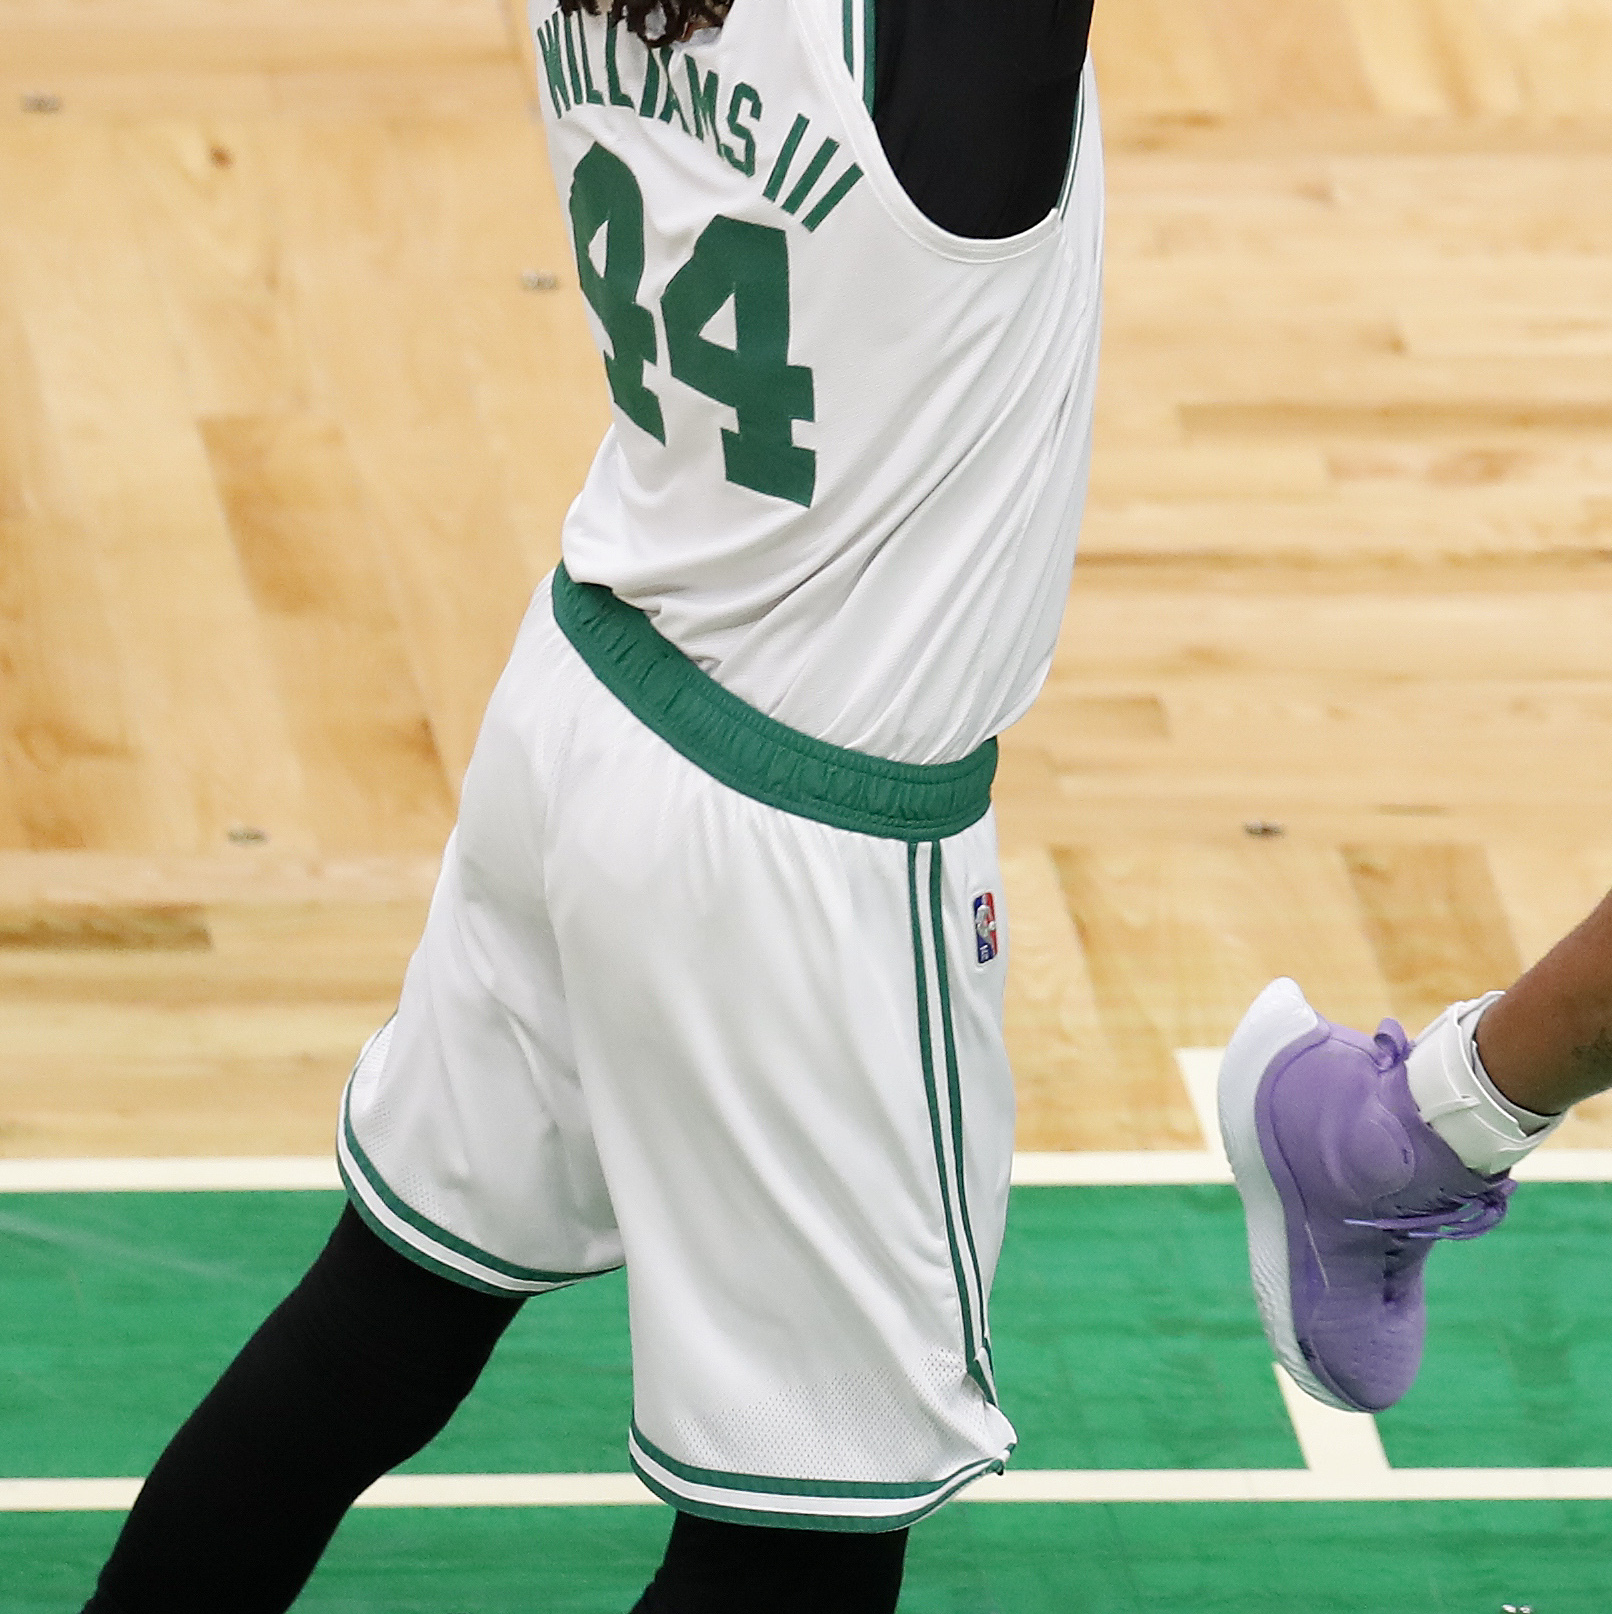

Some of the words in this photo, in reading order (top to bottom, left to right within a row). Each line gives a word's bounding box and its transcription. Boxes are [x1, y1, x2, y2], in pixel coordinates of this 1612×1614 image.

[537, 10, 762, 178] WILLIAMS
[762, 113, 864, 233] III
[569, 141, 816, 509] 44
